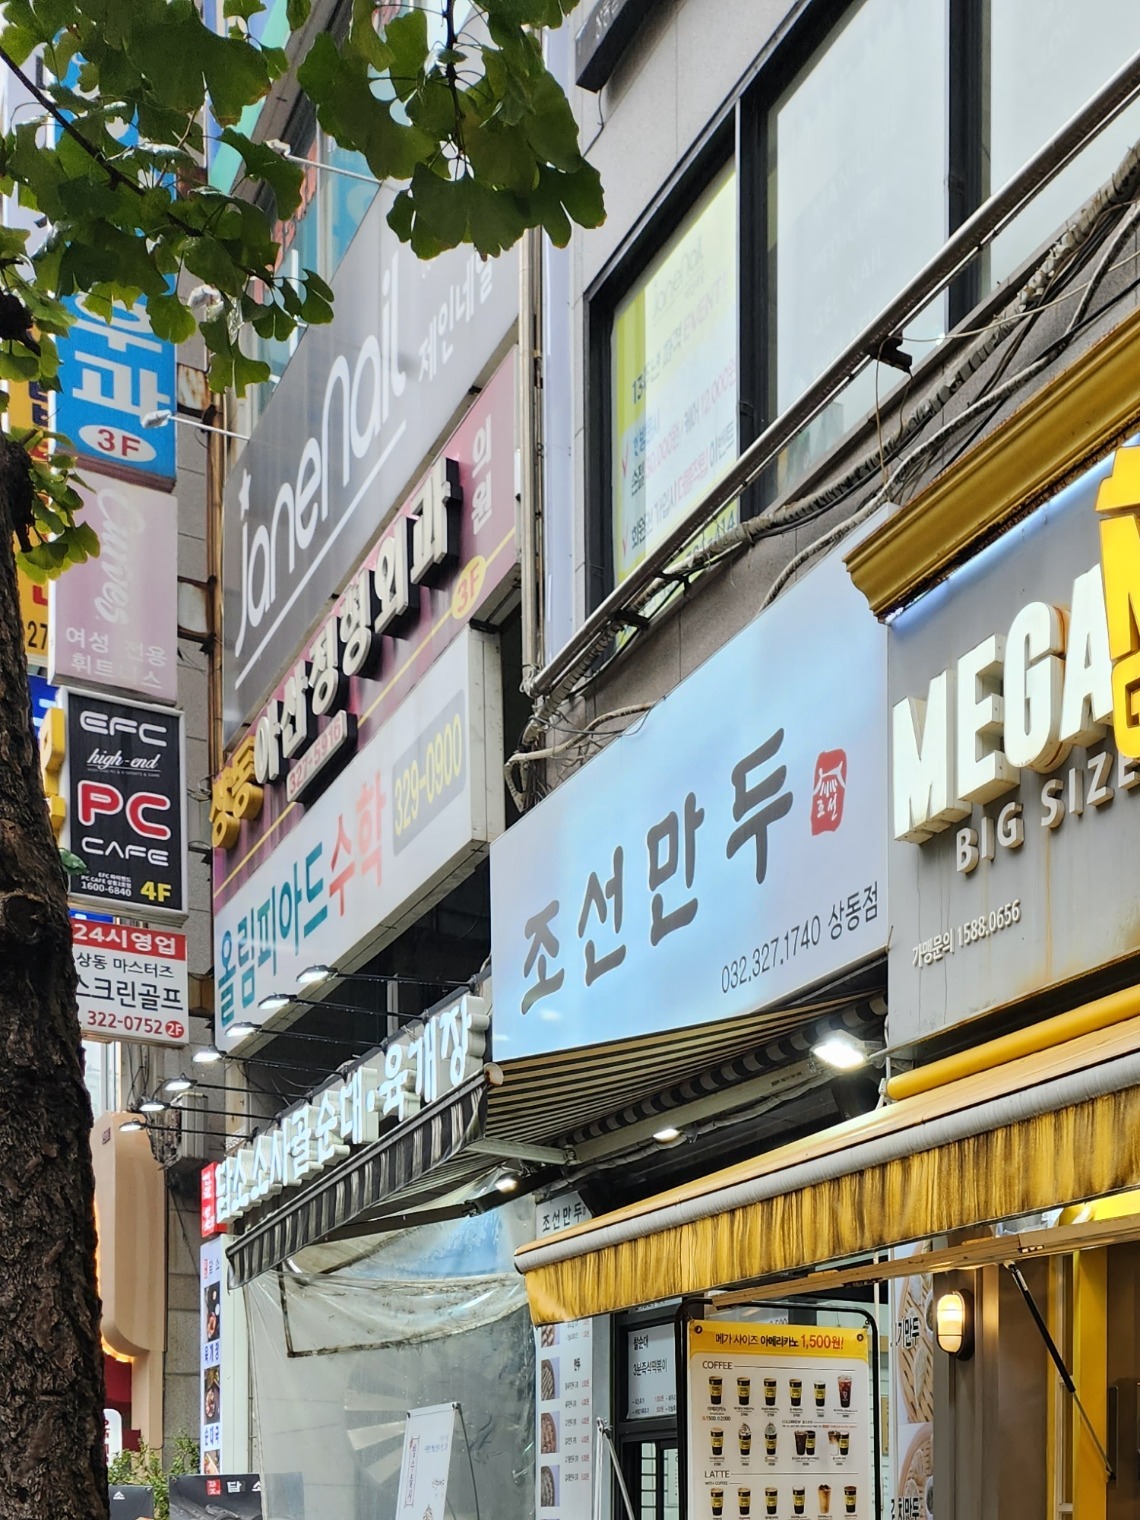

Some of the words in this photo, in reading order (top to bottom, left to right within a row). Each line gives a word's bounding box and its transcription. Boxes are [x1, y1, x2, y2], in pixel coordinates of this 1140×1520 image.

[97, 428, 141, 457] 3F
[470, 413, 493, 536] 의원
[455, 560, 481, 617] 3F
[65, 625, 109, 655] 여성
[892, 562, 1116, 845] MEGA
[79, 710, 168, 748] EFC
[86, 748, 161, 770] high-end
[288, 717, 344, 800] 327-5916
[392, 712, 465, 838] 329-0900
[77, 779, 172, 841] PC
[81, 836, 170, 867] CAFE
[956, 801, 1024, 875] BIG
[520, 727, 794, 1015] 조선만두
[81, 881, 132, 897] 1600-6840
[140, 880, 172, 902] 4F
[217, 841, 330, 1026] 올림피아드
[328, 771, 387, 918] 수학
[73, 923, 176, 956] 24시영업
[721, 914, 821, 994] 032.327.1740
[827, 881, 879, 940] 상동점
[911, 926, 955, 970] 가맹문의
[956, 898, 1023, 949] 1588.0656
[76, 952, 108, 970] 상동
[113, 957, 175, 978] 마스터즈
[87, 1010, 163, 1035] 322-0752
[166, 1022, 184, 1037] 2F
[715, 1333, 732, 1346] 메가
[733, 1334, 759, 1346] 사이즈
[760, 1335, 799, 1348] 아메리카노
[800, 1333, 844, 1350] 1,500원!
[896, 1316, 920, 1347] 기만두
[702, 1361, 733, 1371] COFFEE
[704, 1470, 731, 1479] LATTE
